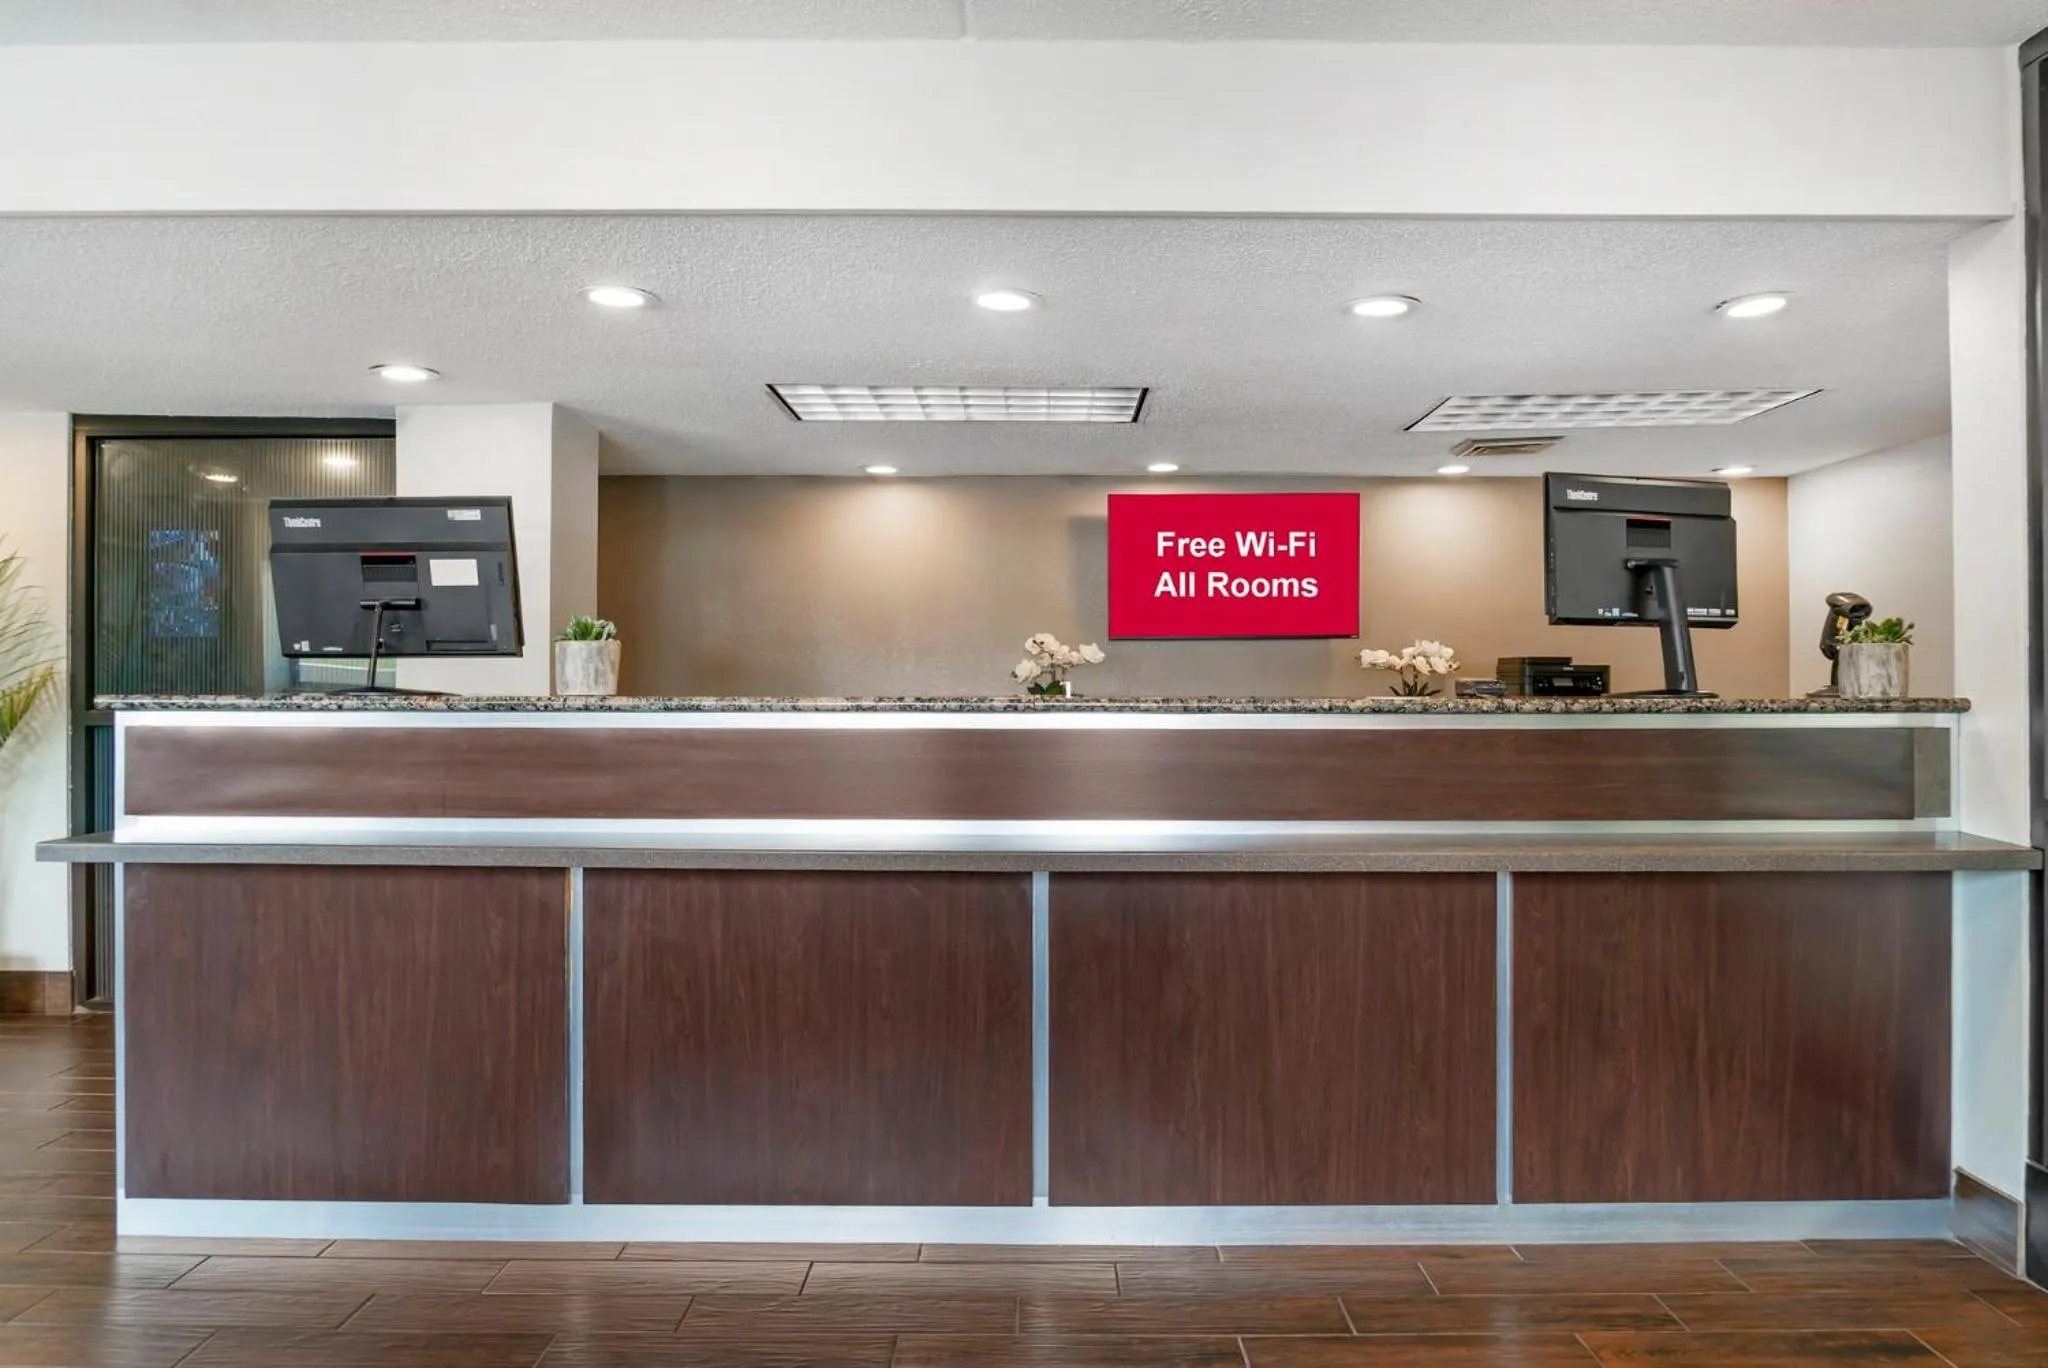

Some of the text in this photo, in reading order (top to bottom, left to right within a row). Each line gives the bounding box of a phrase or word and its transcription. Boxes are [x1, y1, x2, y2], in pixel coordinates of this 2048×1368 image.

[1156, 531, 1316, 558] Free Wi-Fi
[1154, 571, 1319, 598] All Rooms
